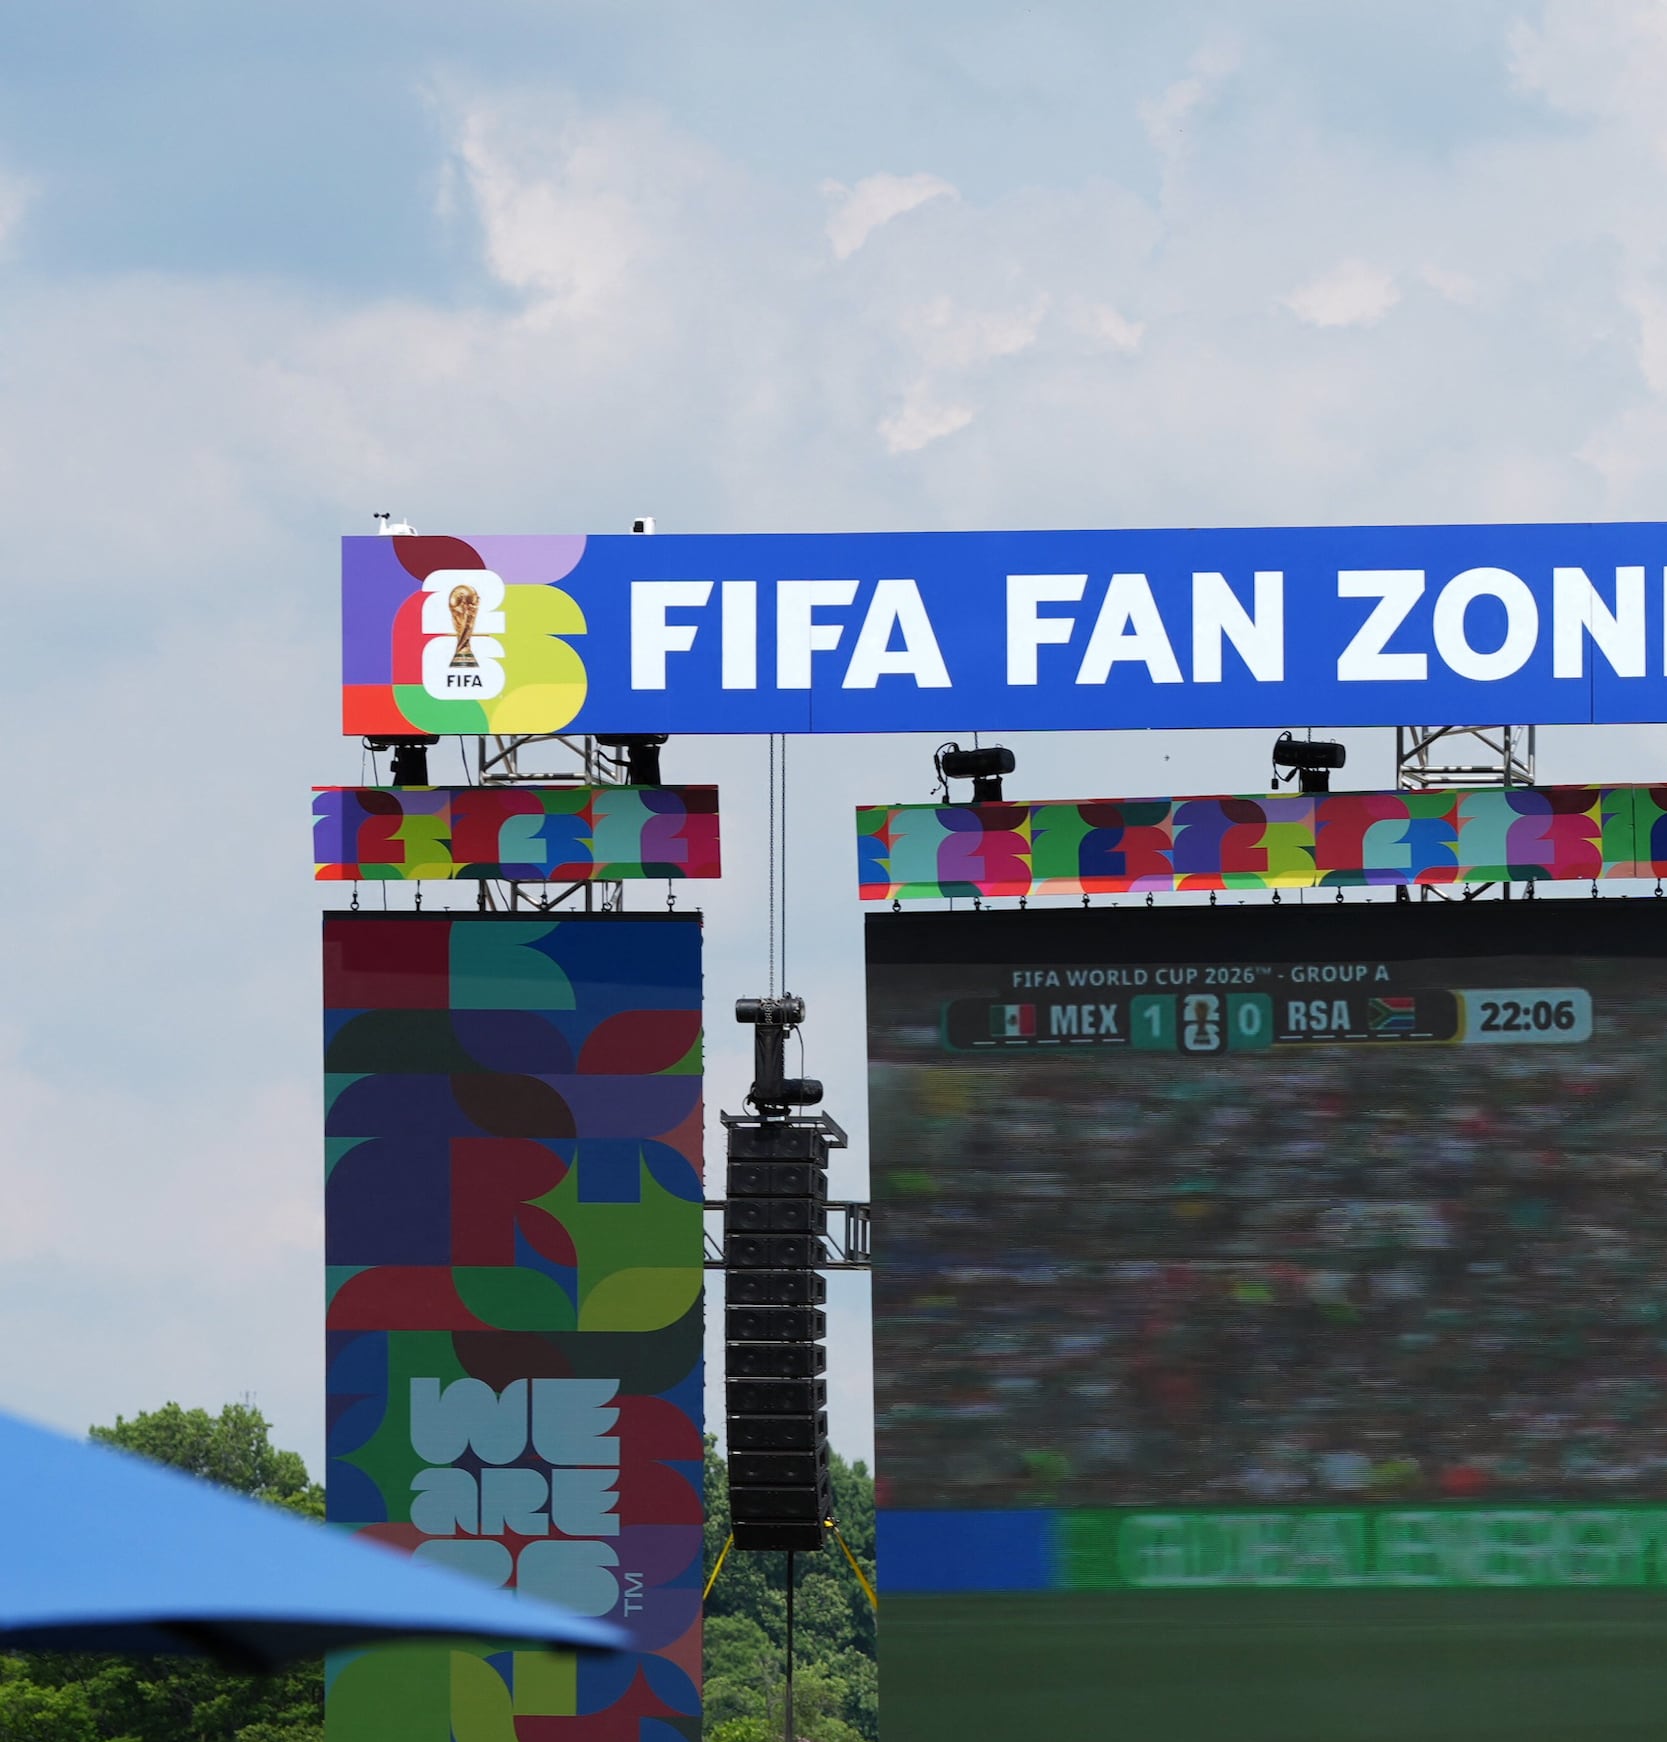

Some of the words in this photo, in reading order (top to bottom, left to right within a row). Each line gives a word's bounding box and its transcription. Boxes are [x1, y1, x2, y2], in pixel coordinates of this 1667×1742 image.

[631, 579, 952, 690] FIFA
[1006, 571, 1284, 685] FAN
[447, 674, 482, 688] FIFA
[1013, 970, 1060, 987] FIFA
[1066, 969, 1148, 986] WORLD
[1155, 968, 1198, 985] CUP
[1291, 965, 1368, 982] GROUP
[1375, 965, 1390, 981] A
[1051, 1003, 1119, 1036] MEX
[1143, 1003, 1161, 1037] 1
[1238, 1003, 1263, 1037] 0
[1288, 1000, 1351, 1031] RSA
[1480, 1001, 1576, 1032] 22:06
[410, 1377, 620, 1465] WE
